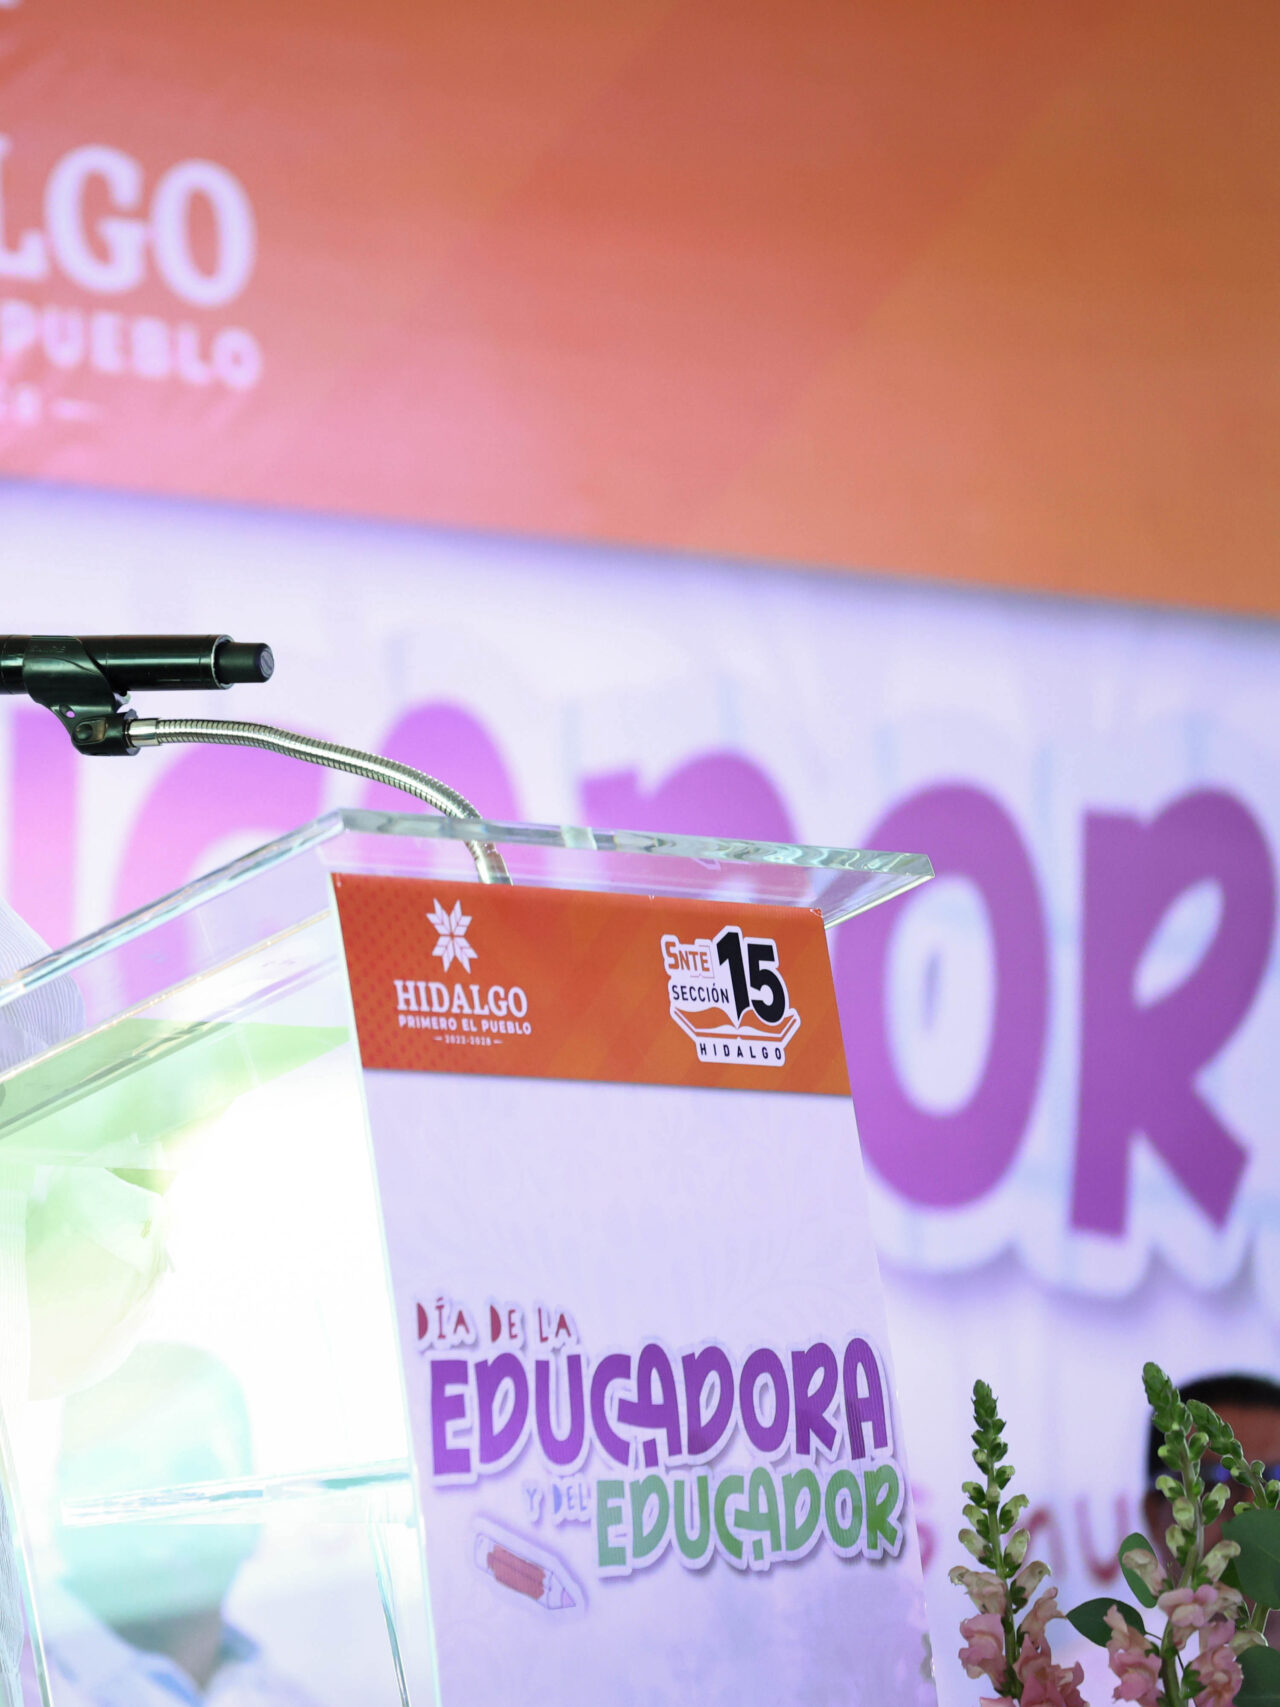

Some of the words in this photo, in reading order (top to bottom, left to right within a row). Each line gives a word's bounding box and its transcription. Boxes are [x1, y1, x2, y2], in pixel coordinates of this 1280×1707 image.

[665, 941, 711, 972] SNTE
[671, 982, 730, 1003] SECCIÓN
[716, 931, 786, 1023] 15
[393, 979, 528, 1018] HIDALGO
[398, 1014, 458, 1031] PRIMERO
[461, 1018, 478, 1032] EL
[481, 1019, 532, 1035] PUEBLO
[699, 1043, 782, 1061] HIDALGO
[416, 1296, 470, 1341] DÍA
[490, 1304, 518, 1343] DE
[538, 1307, 572, 1343] LA
[430, 1337, 889, 1476] EDUCADORA
[526, 1487, 538, 1512] Y
[552, 1483, 588, 1514] DEL
[596, 1464, 899, 1568] EDUCADOR
